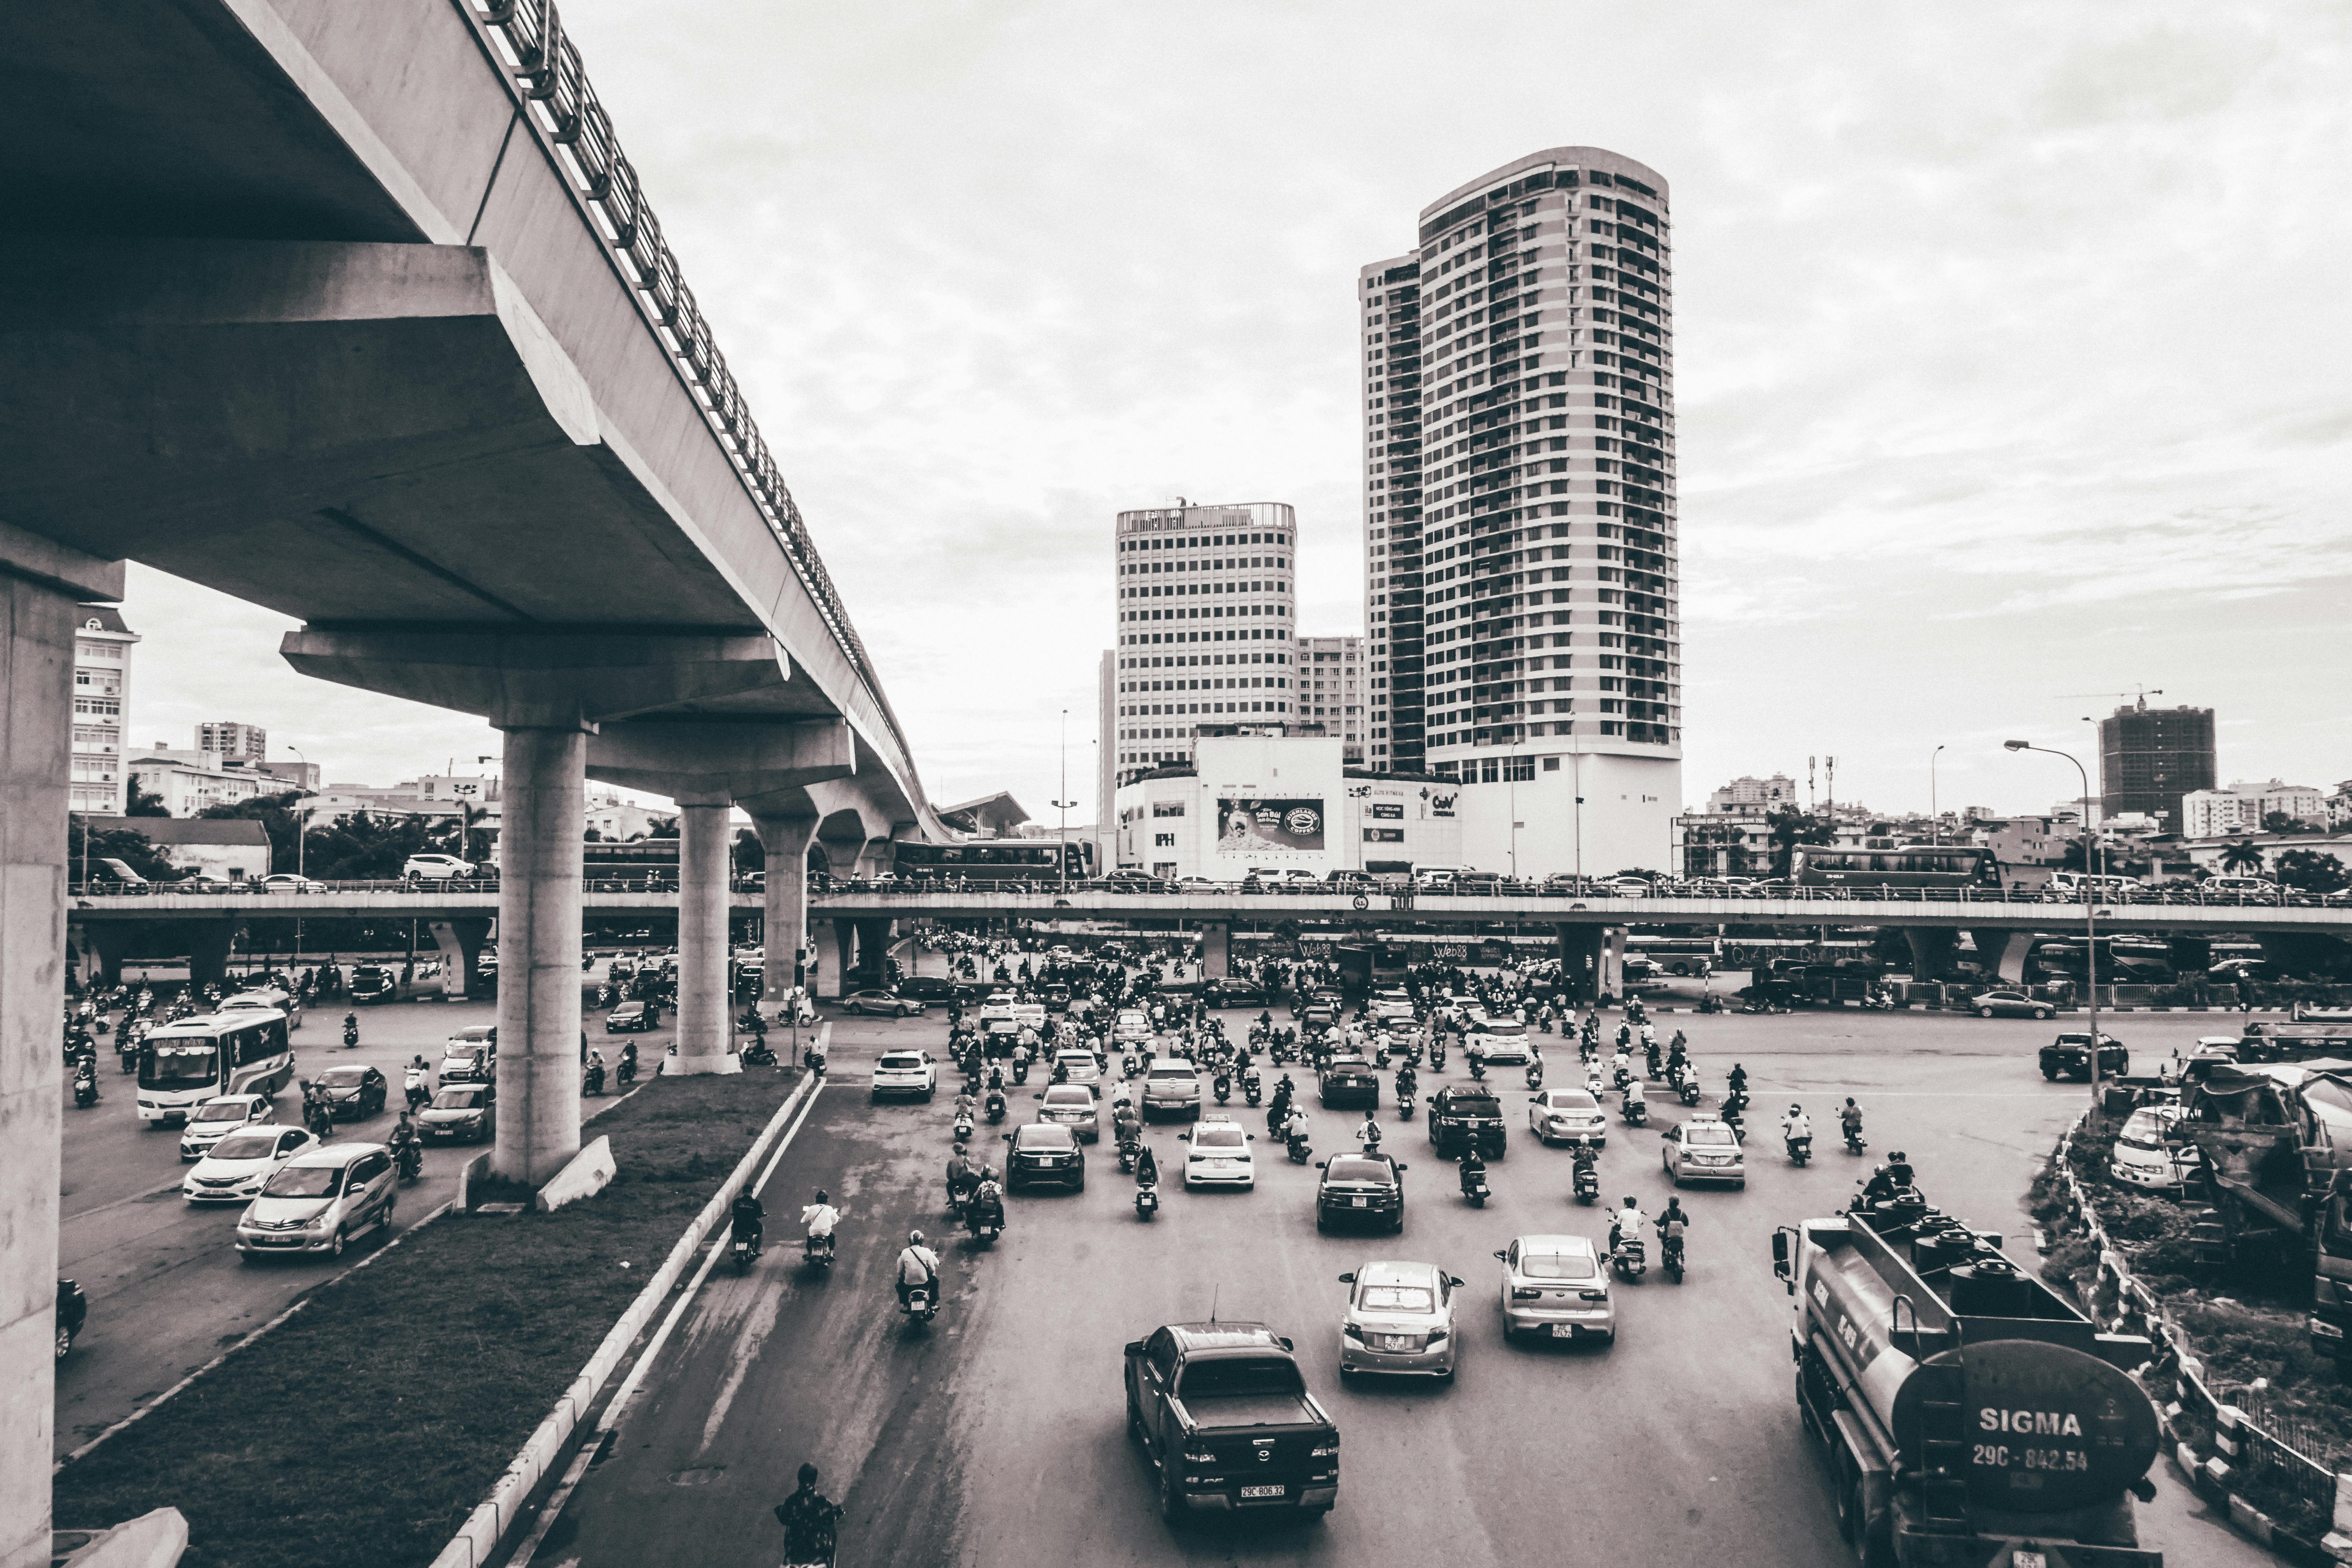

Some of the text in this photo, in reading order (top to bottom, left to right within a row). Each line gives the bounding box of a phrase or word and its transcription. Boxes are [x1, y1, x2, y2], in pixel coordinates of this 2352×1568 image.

[1287, 809, 1317, 820] HIGHLANDS
[1299, 943, 1331, 957] Web88
[1433, 944, 1467, 958] Web88
[1980, 1408, 2082, 1436] SIGMA
[1973, 1444, 2009, 1467] 29C
